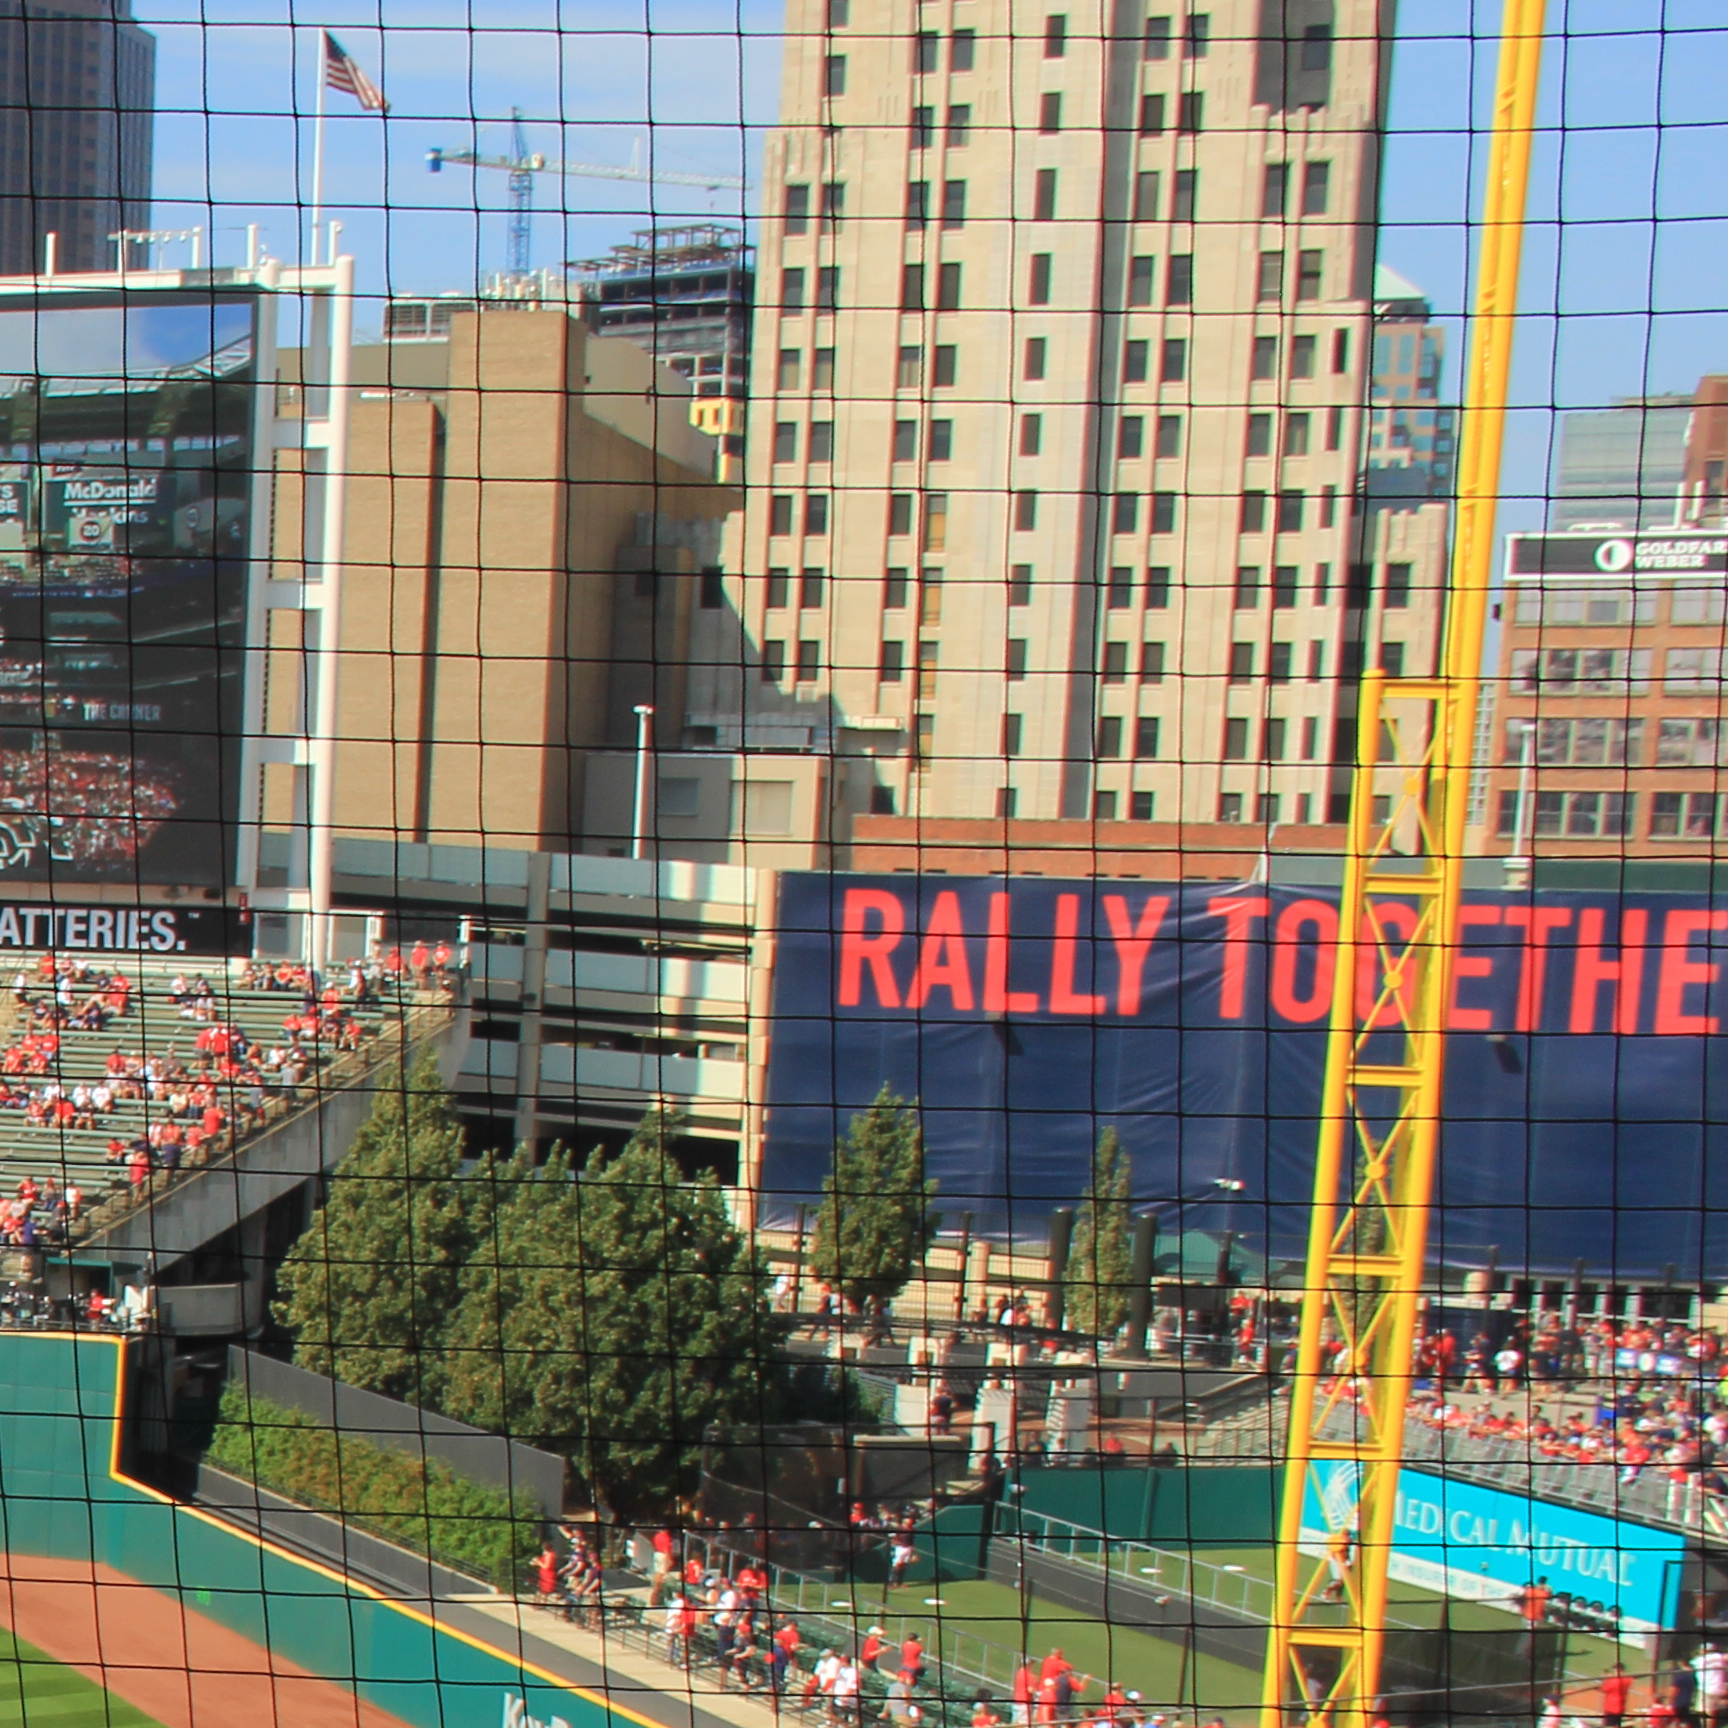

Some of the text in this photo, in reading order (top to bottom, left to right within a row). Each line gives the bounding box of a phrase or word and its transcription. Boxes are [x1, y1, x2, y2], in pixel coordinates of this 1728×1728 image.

[64, 480, 157, 499] McDonald
[1635, 554, 1707, 568] WEBER
[838, 888, 1170, 1017] RALLY
[1509, 1517, 1637, 1588] MUTUAL
